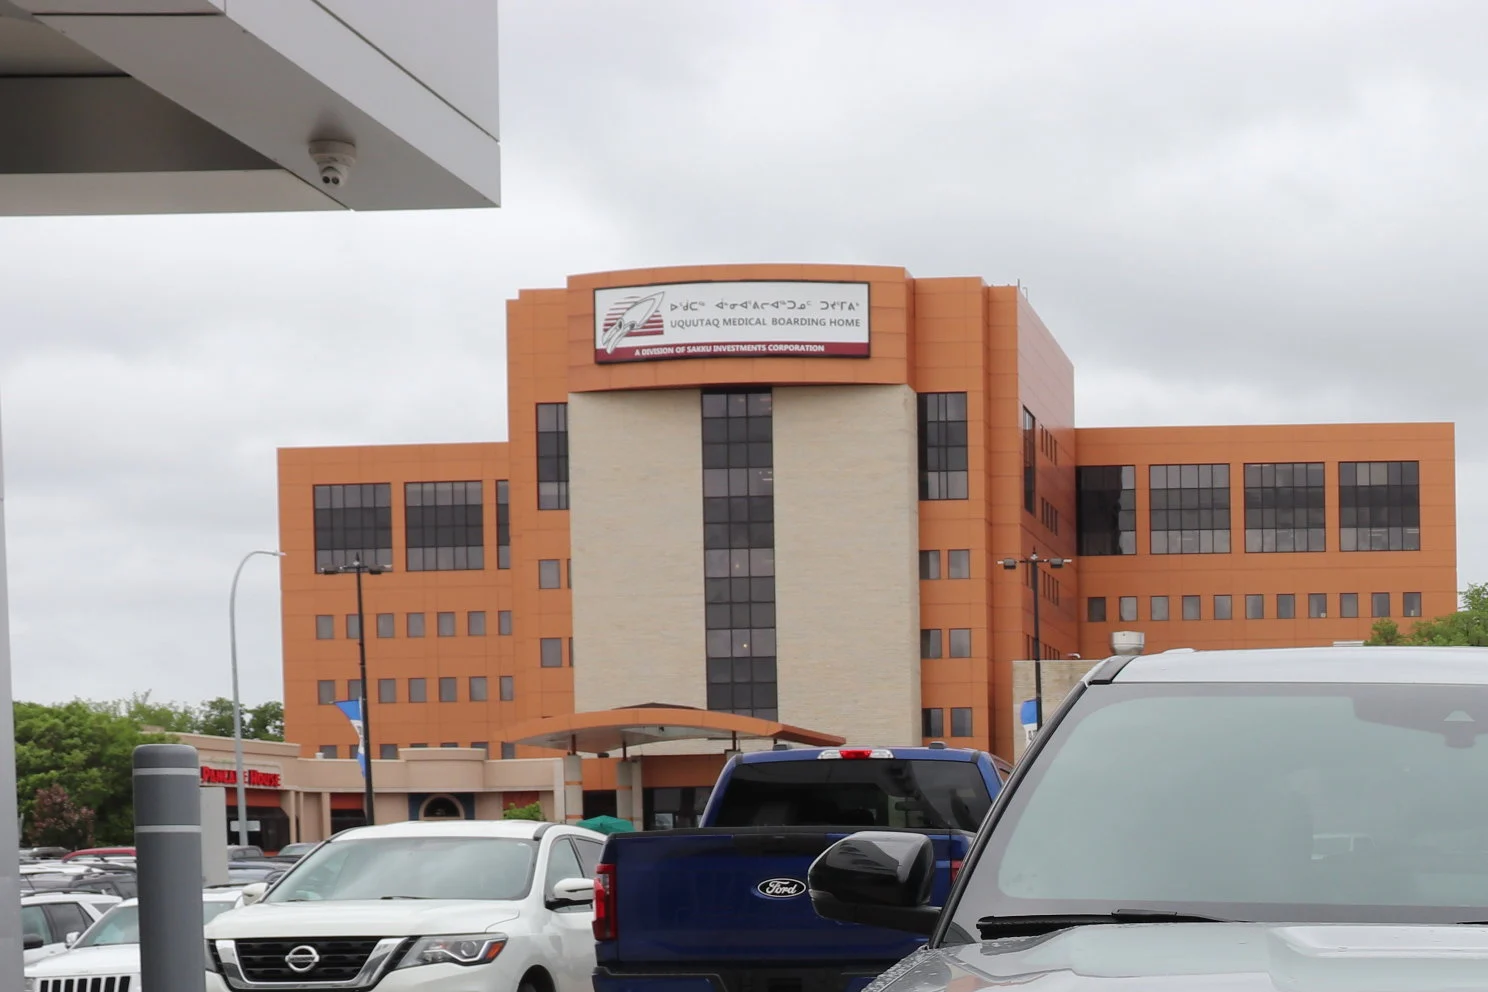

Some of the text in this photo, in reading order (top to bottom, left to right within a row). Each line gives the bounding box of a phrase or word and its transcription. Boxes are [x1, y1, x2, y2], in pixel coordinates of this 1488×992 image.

[670, 317, 861, 330] UQUUTAQ MEDICAL BOARDING HOME
[641, 347, 674, 356] DIVISION
[675, 346, 686, 354] OF
[687, 345, 712, 353] SAKKU
[713, 343, 767, 352] INVESTMENTS
[767, 343, 825, 352] CORPORATION
[201, 766, 248, 785] PANCAE
[766, 881, 797, 894] Ford
